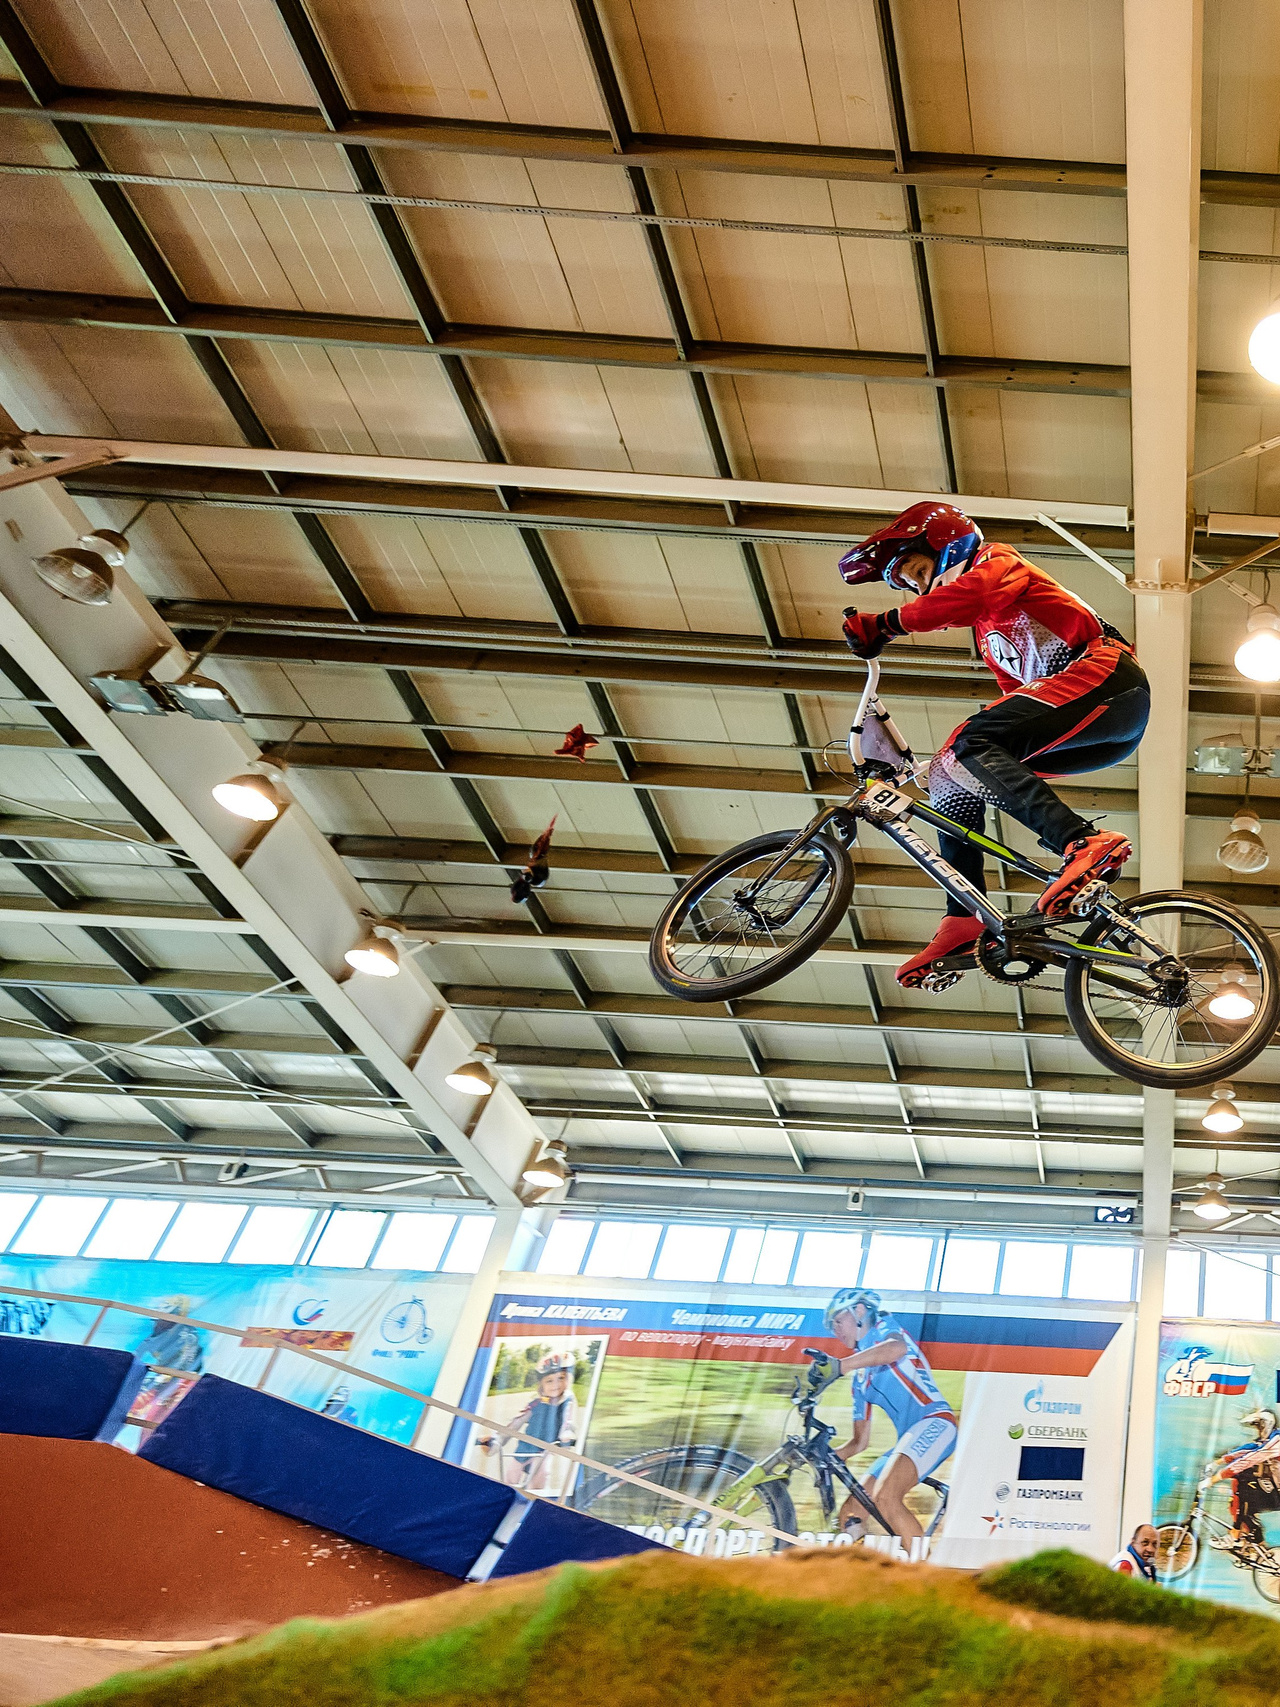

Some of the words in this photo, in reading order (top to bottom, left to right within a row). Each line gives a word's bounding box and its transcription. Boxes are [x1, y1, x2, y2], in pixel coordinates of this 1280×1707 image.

[873, 789, 900, 808] 81
[891, 822, 972, 893] MEYBO
[671, 1309, 756, 1328] Чемпионка
[755, 1313, 806, 1330] МИРА
[1163, 1379, 1217, 1398] ФВСР
[1028, 1425, 1088, 1438] СБЕРБАНК
[1017, 1488, 1083, 1501] ГАЗПРОМБАНК
[1009, 1517, 1091, 1532] Ростехнологии
